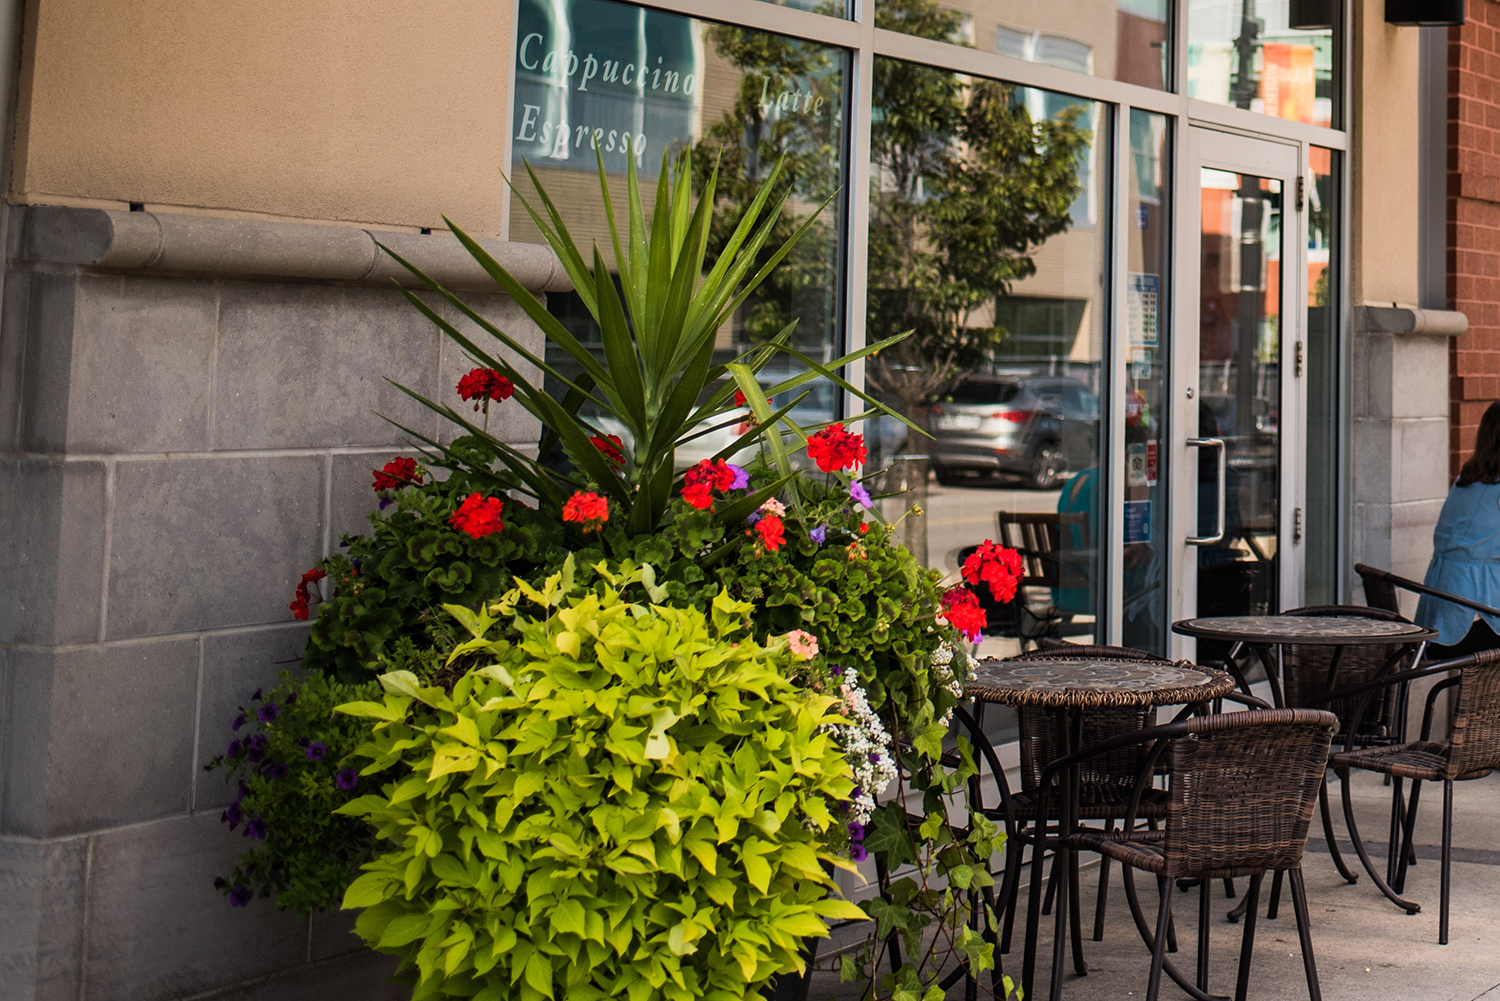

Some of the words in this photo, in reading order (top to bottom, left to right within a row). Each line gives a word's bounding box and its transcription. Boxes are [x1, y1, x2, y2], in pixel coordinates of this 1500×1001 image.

[519, 32, 696, 96] Cappuccino
[758, 75, 824, 116] Latte
[516, 103, 648, 161] Espresso
